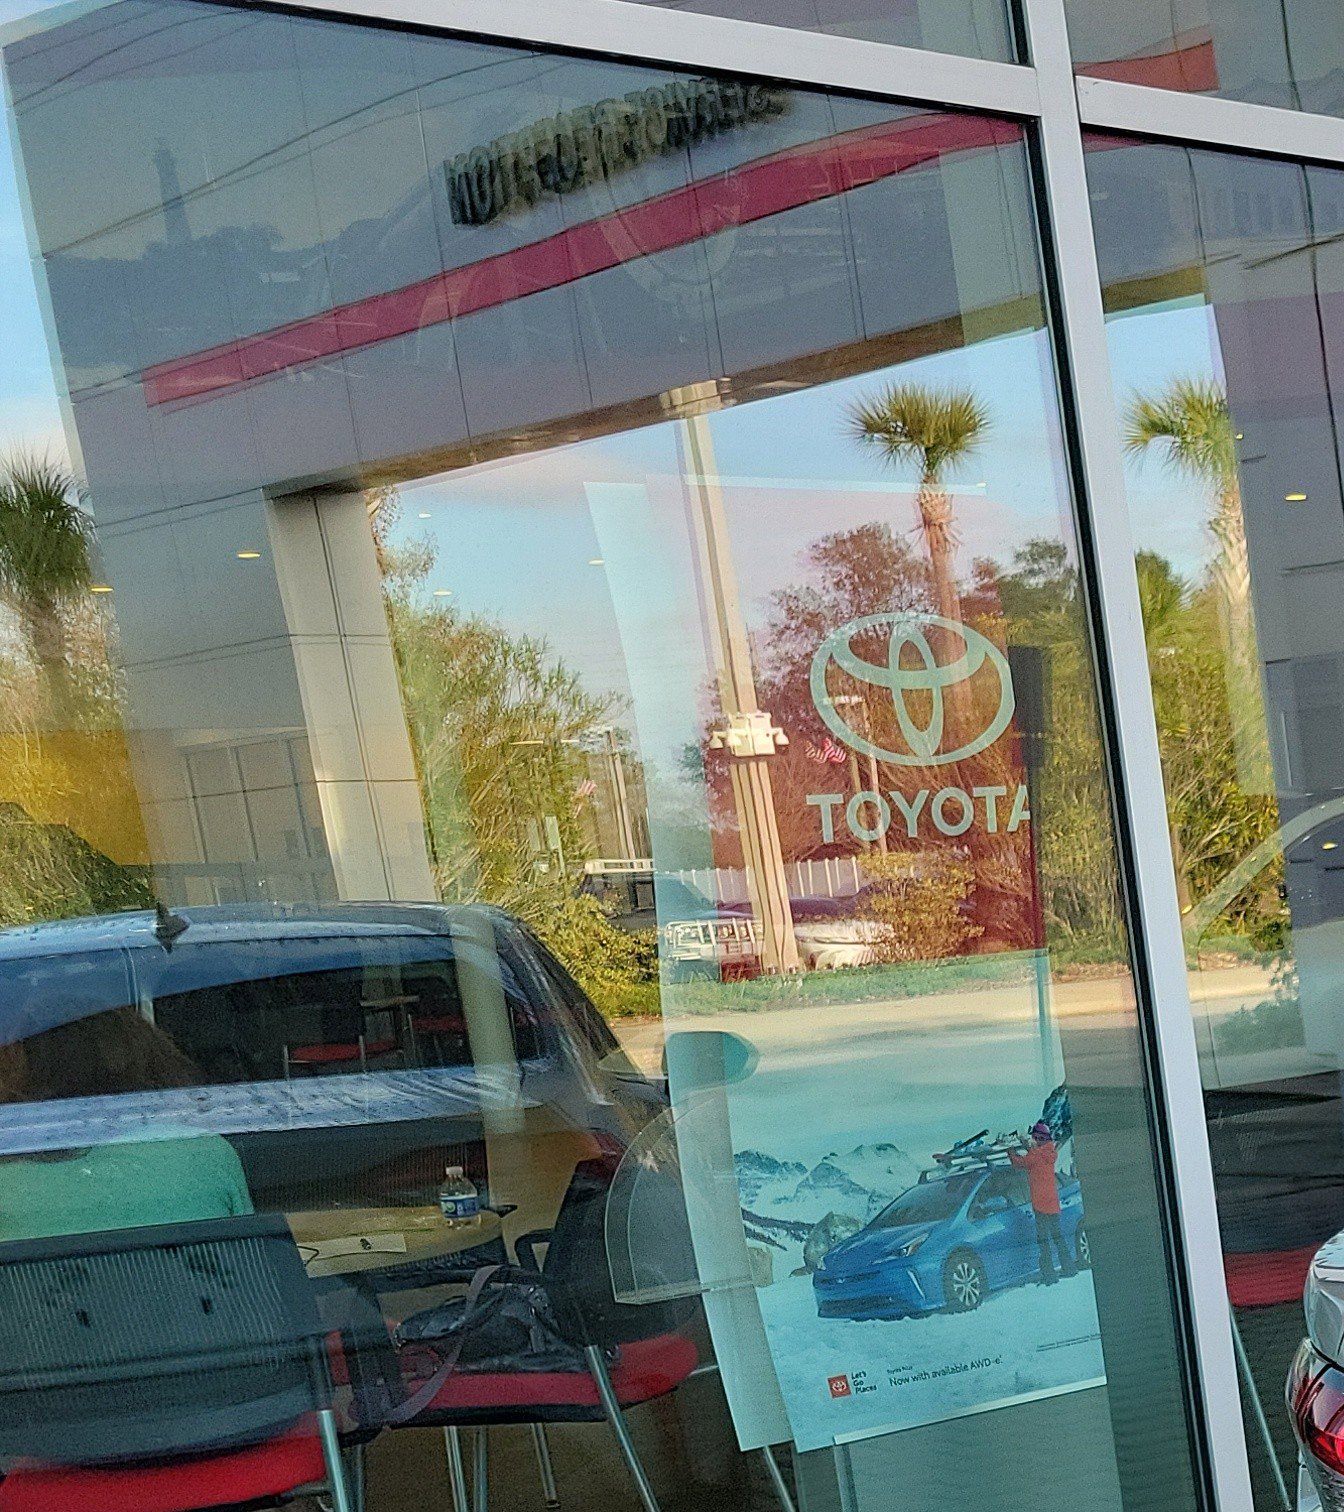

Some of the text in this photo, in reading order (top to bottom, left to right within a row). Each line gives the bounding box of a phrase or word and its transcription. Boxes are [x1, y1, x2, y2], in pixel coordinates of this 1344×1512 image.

[806, 785, 1031, 844] TOYOTA
[853, 1379, 864, 1387] Go
[889, 1377, 910, 1387] Now
[911, 1370, 931, 1382] with
[932, 1363, 969, 1379] available
[855, 1384, 878, 1395] Places
